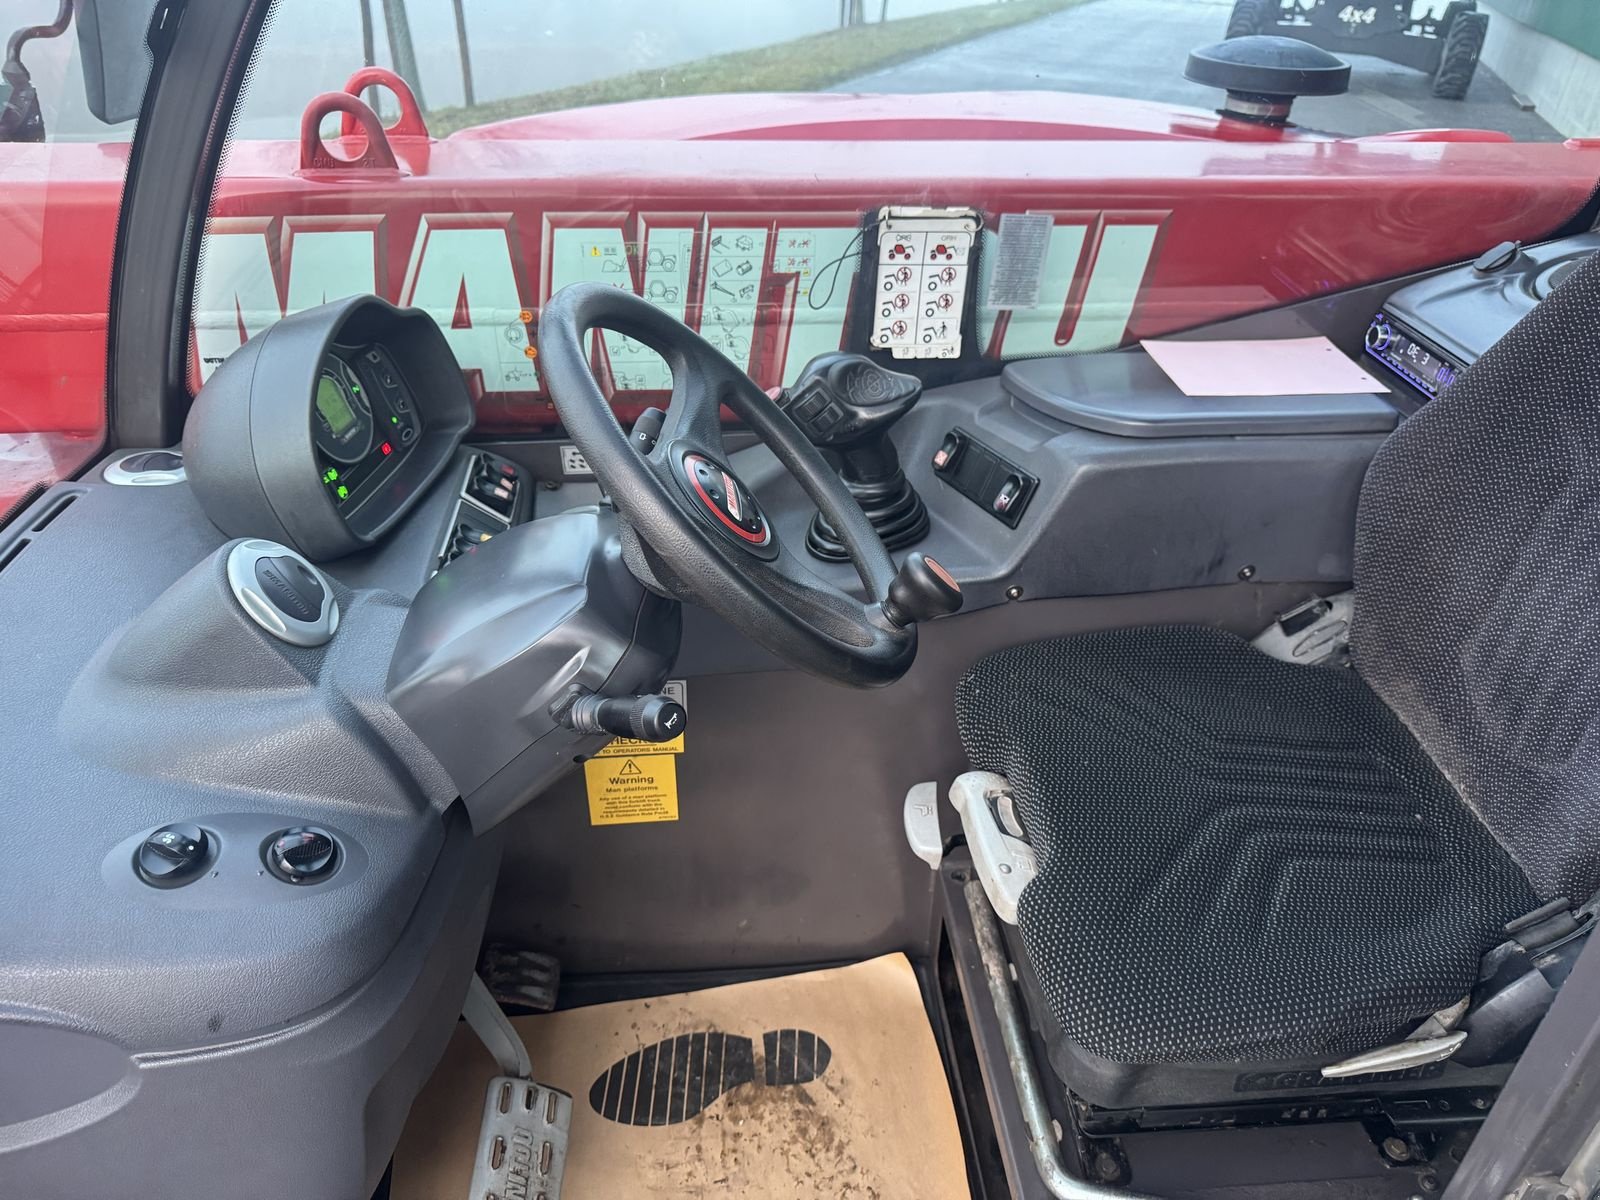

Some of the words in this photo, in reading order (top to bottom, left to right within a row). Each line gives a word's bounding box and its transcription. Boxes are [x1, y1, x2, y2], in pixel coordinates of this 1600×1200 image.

[1338, 4, 1377, 24] 4x4
[188, 209, 1174, 404] MANITU
[608, 776, 654, 785] Warning
